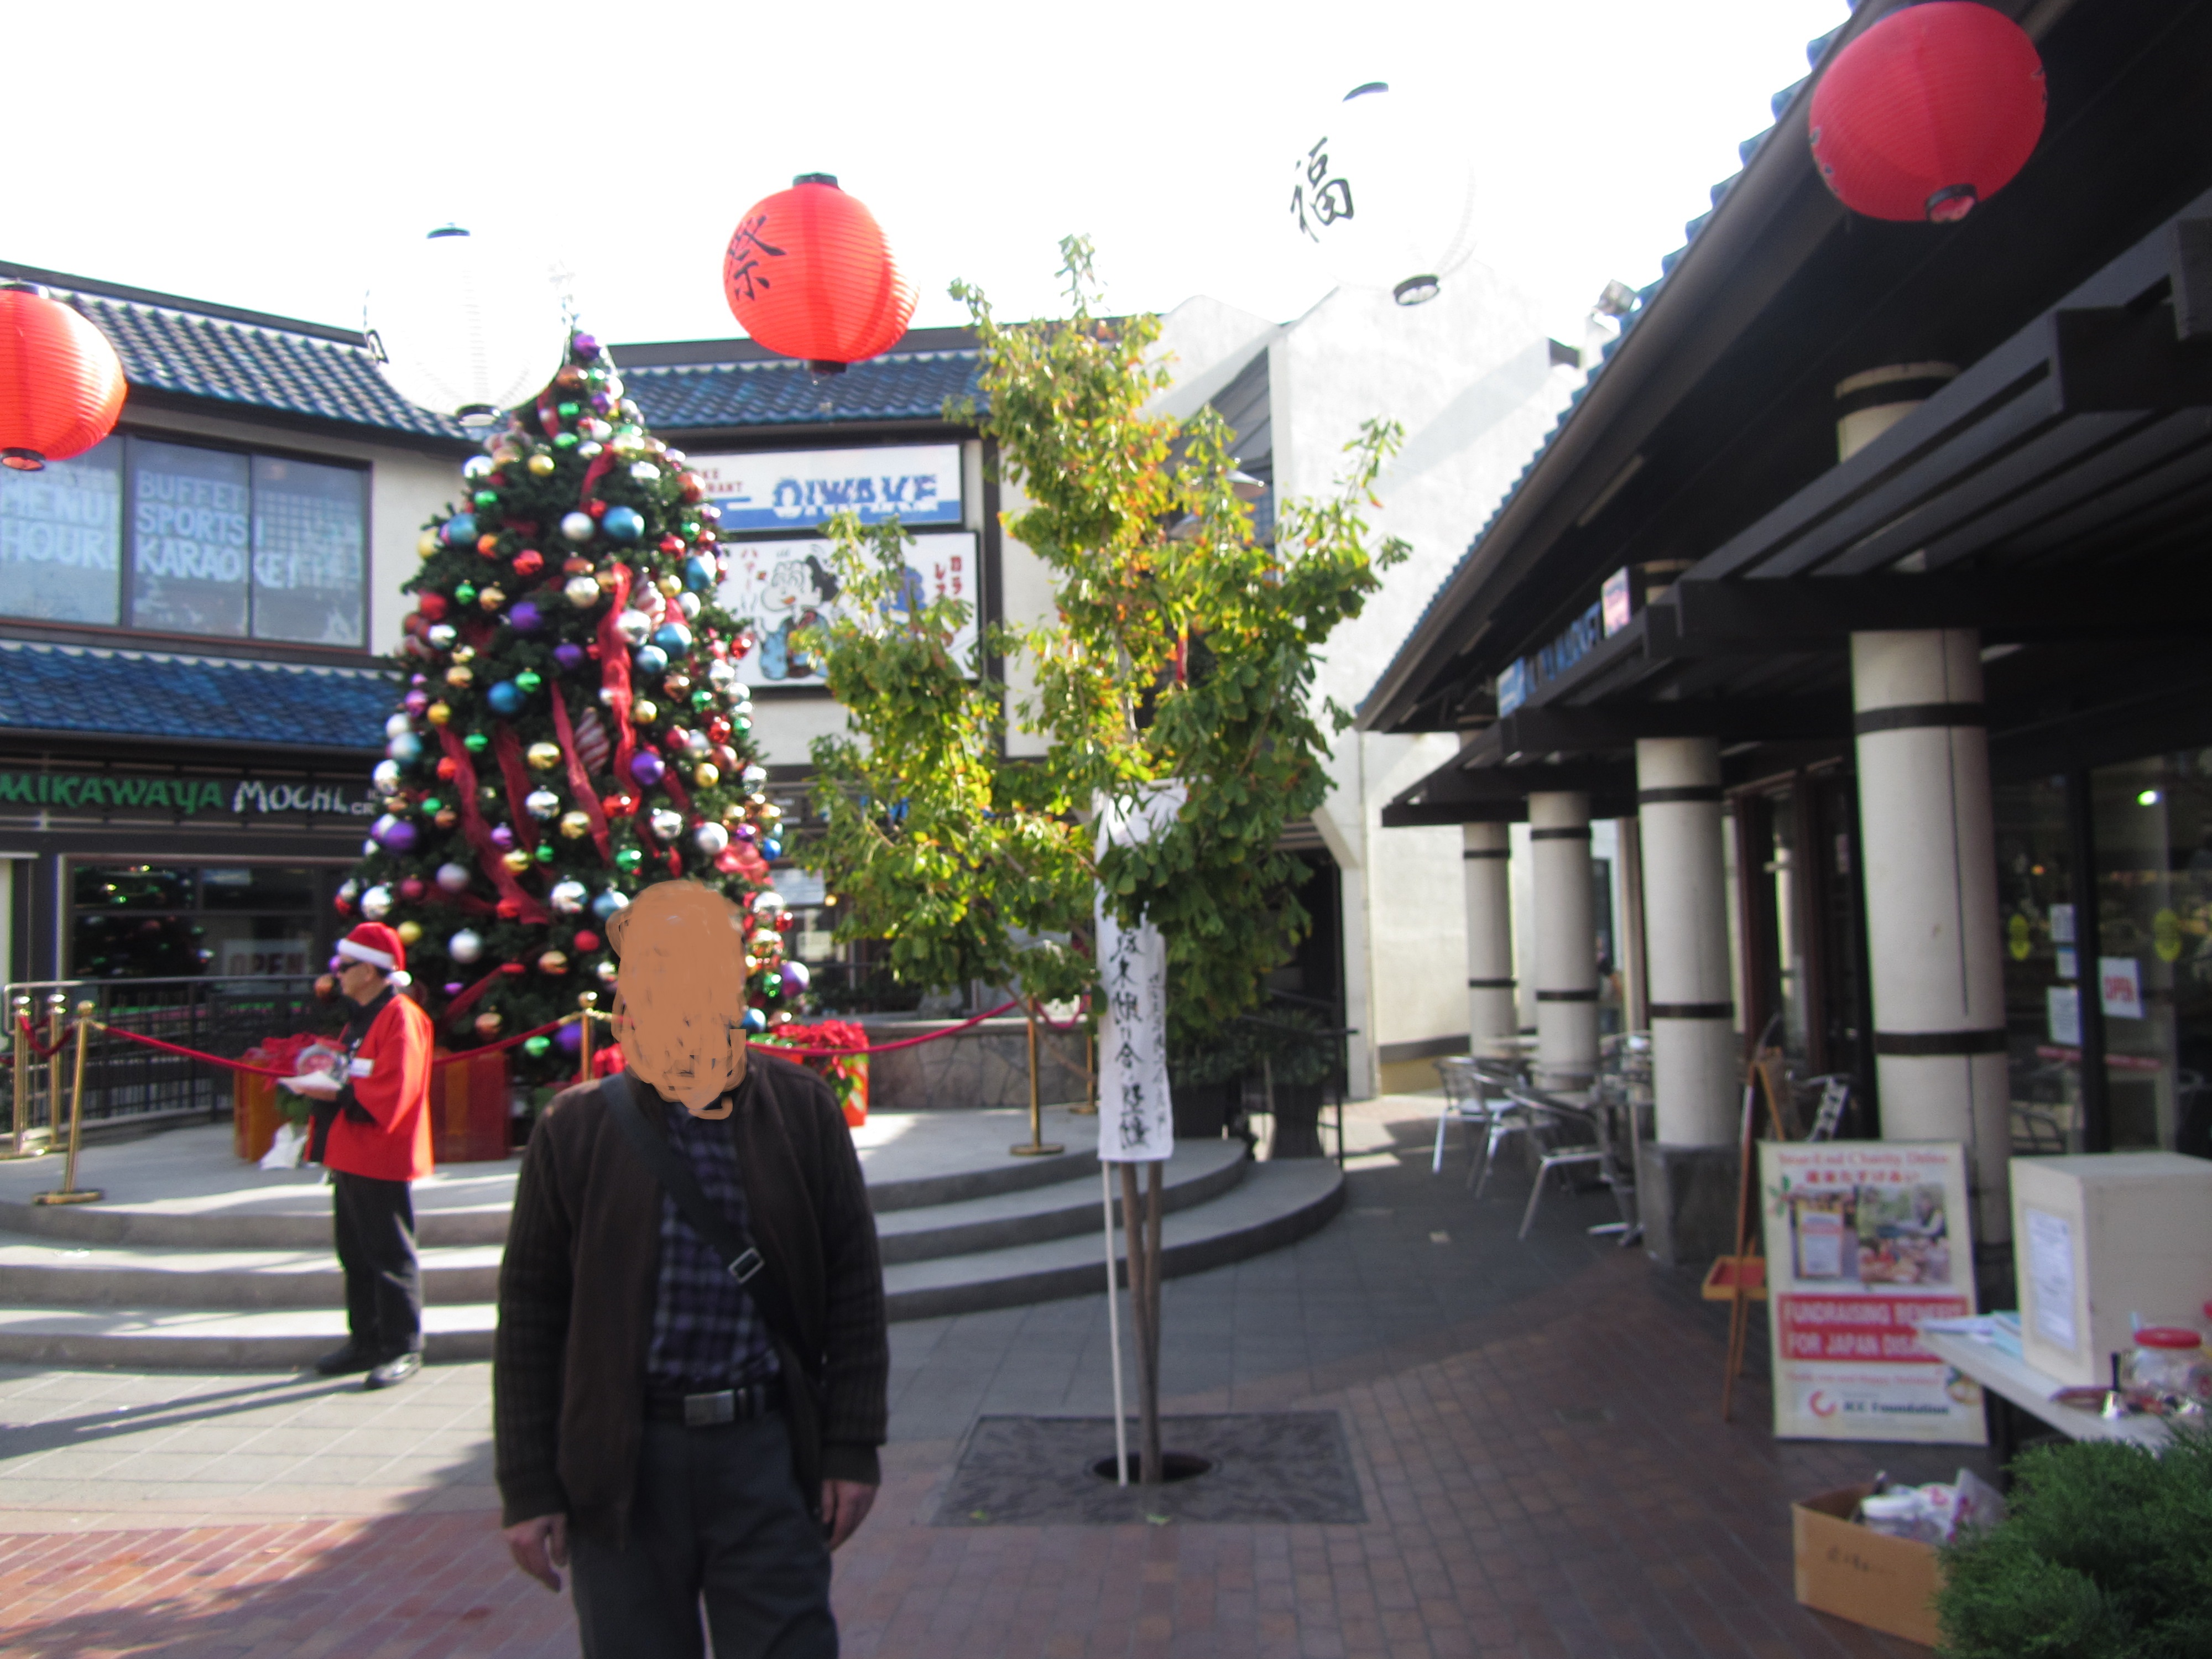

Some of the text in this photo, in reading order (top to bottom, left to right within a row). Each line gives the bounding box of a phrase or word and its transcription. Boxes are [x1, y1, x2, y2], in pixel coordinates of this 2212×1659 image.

[1290, 135, 1354, 243] 福
[136, 470, 247, 513] BUFFET
[772, 474, 938, 519] OIWAKE
[0, 775, 347, 814] MIKAWAYA MOCHI
[1787, 1332, 1820, 1355] FOR
[1825, 1333, 1879, 1357] JAPAN
